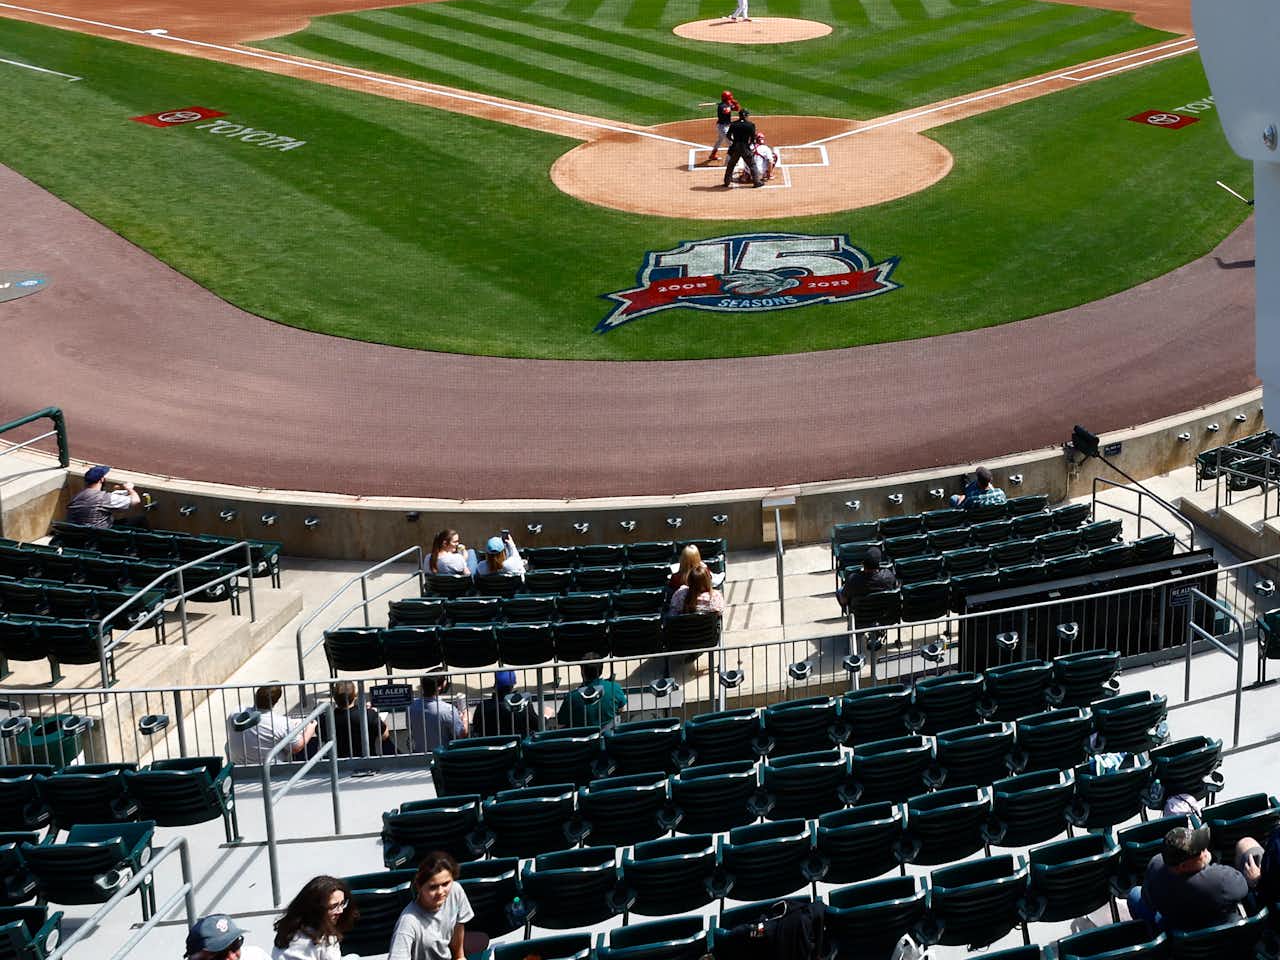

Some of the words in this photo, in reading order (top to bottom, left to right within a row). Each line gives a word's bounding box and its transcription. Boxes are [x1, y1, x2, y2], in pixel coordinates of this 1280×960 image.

[195, 120, 307, 151] TOYOTA
[655, 237, 858, 277] 15
[658, 282, 708, 292] 2008
[808, 279, 849, 288] 2023
[717, 295, 798, 308] SEASONS
[385, 687, 409, 696] ALERT
